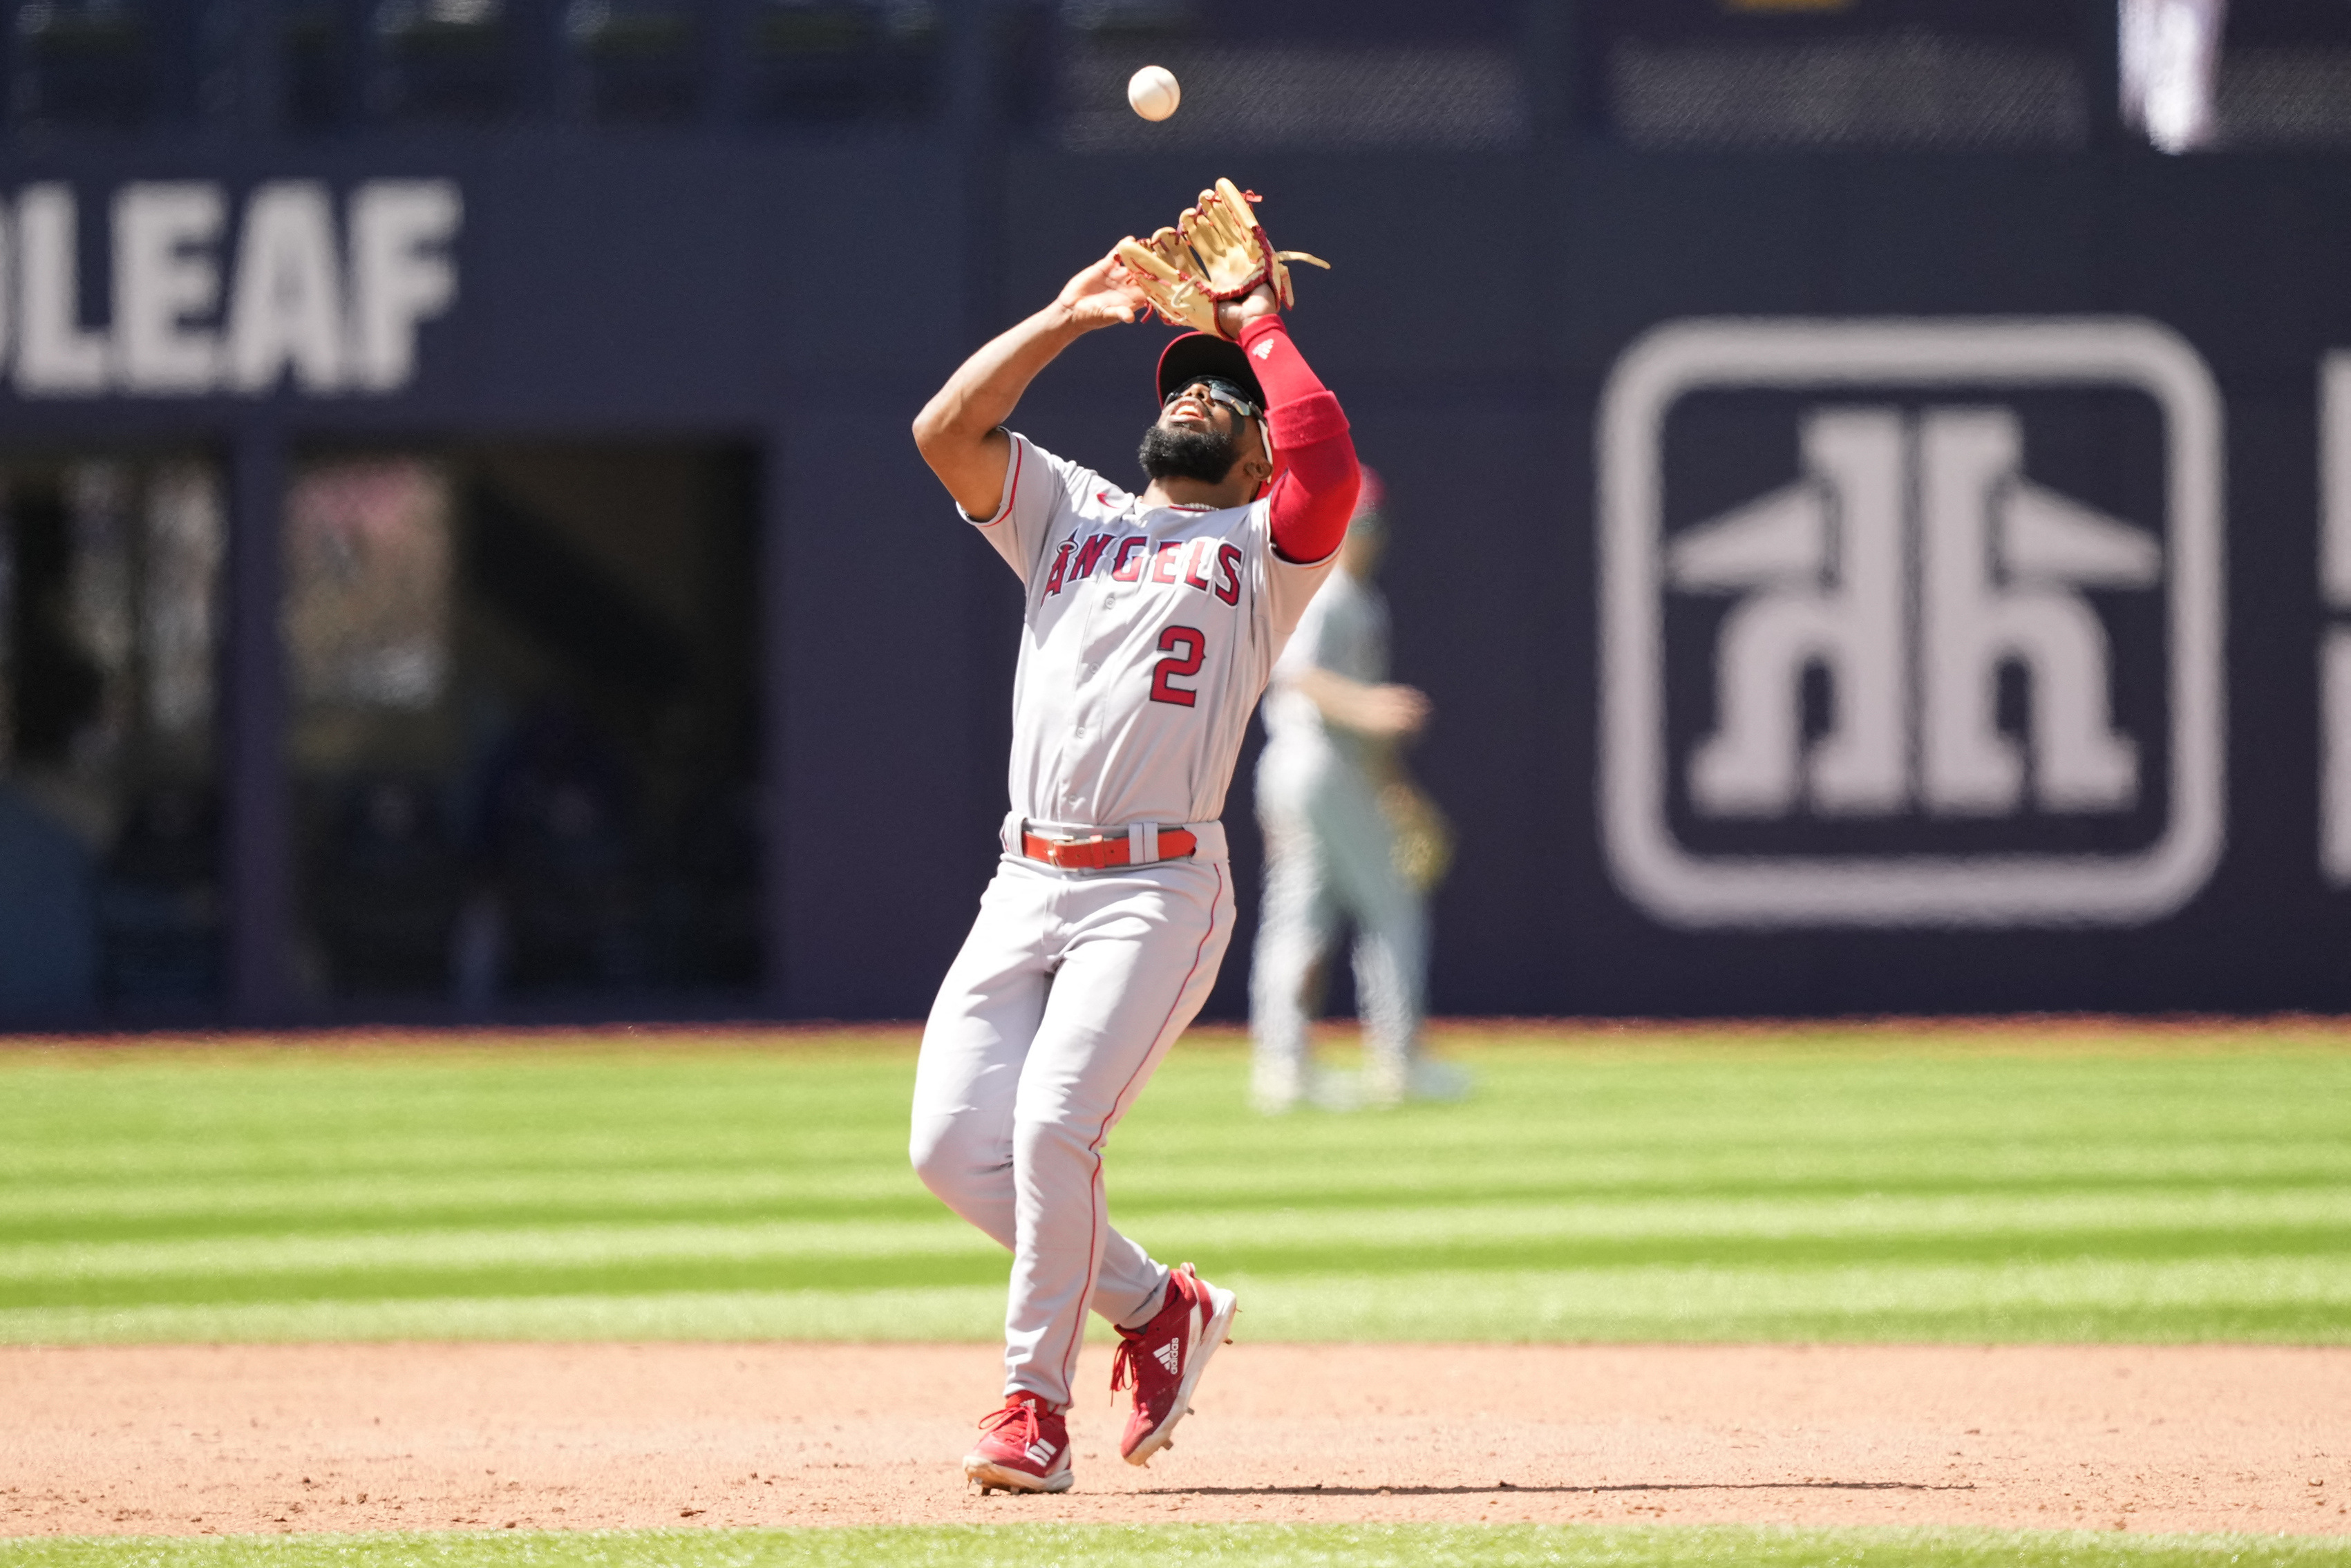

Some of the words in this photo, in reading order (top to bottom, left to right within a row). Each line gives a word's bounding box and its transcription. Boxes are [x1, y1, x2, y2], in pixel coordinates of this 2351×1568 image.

[0, 178, 462, 397] LEAF
[1039, 525, 1243, 608] ANGELS
[1150, 625, 1205, 707] 2
[1170, 1337, 1179, 1375] adidas
